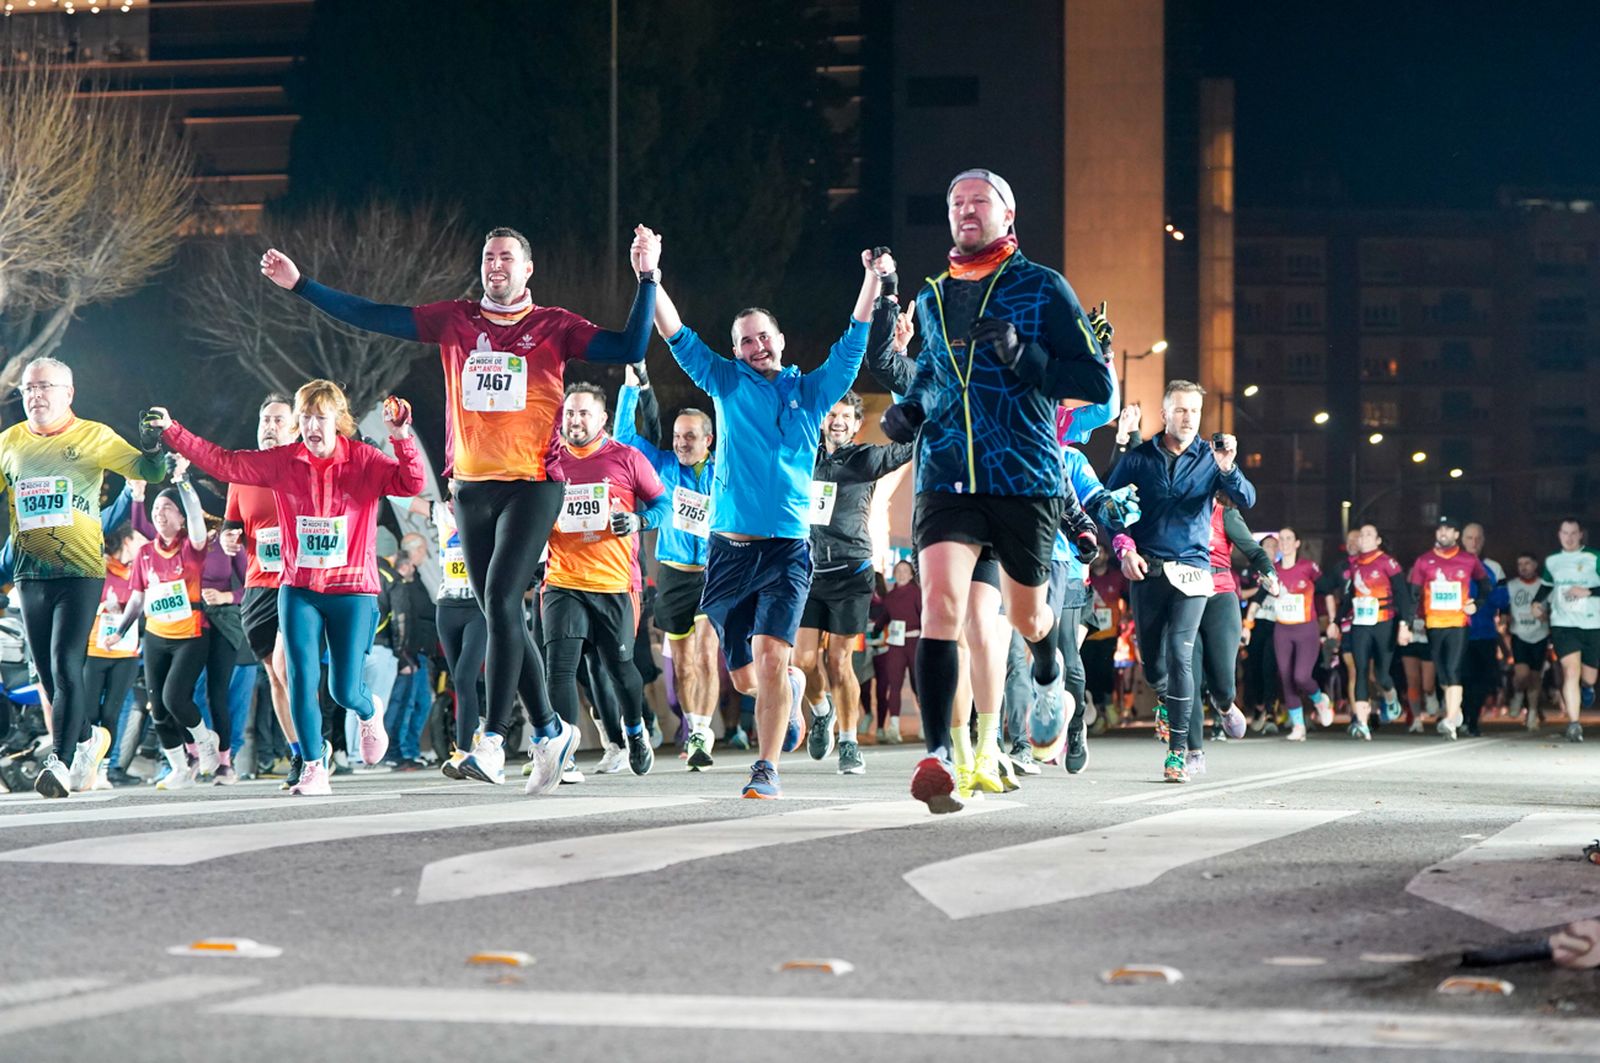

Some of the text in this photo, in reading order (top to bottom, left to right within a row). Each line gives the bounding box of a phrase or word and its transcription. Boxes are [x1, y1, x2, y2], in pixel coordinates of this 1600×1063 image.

[476, 373, 512, 391] 7467
[22, 494, 64, 512] 13479
[567, 500, 600, 516] 4299
[678, 502, 706, 522] 2755
[307, 535, 339, 550] 8144
